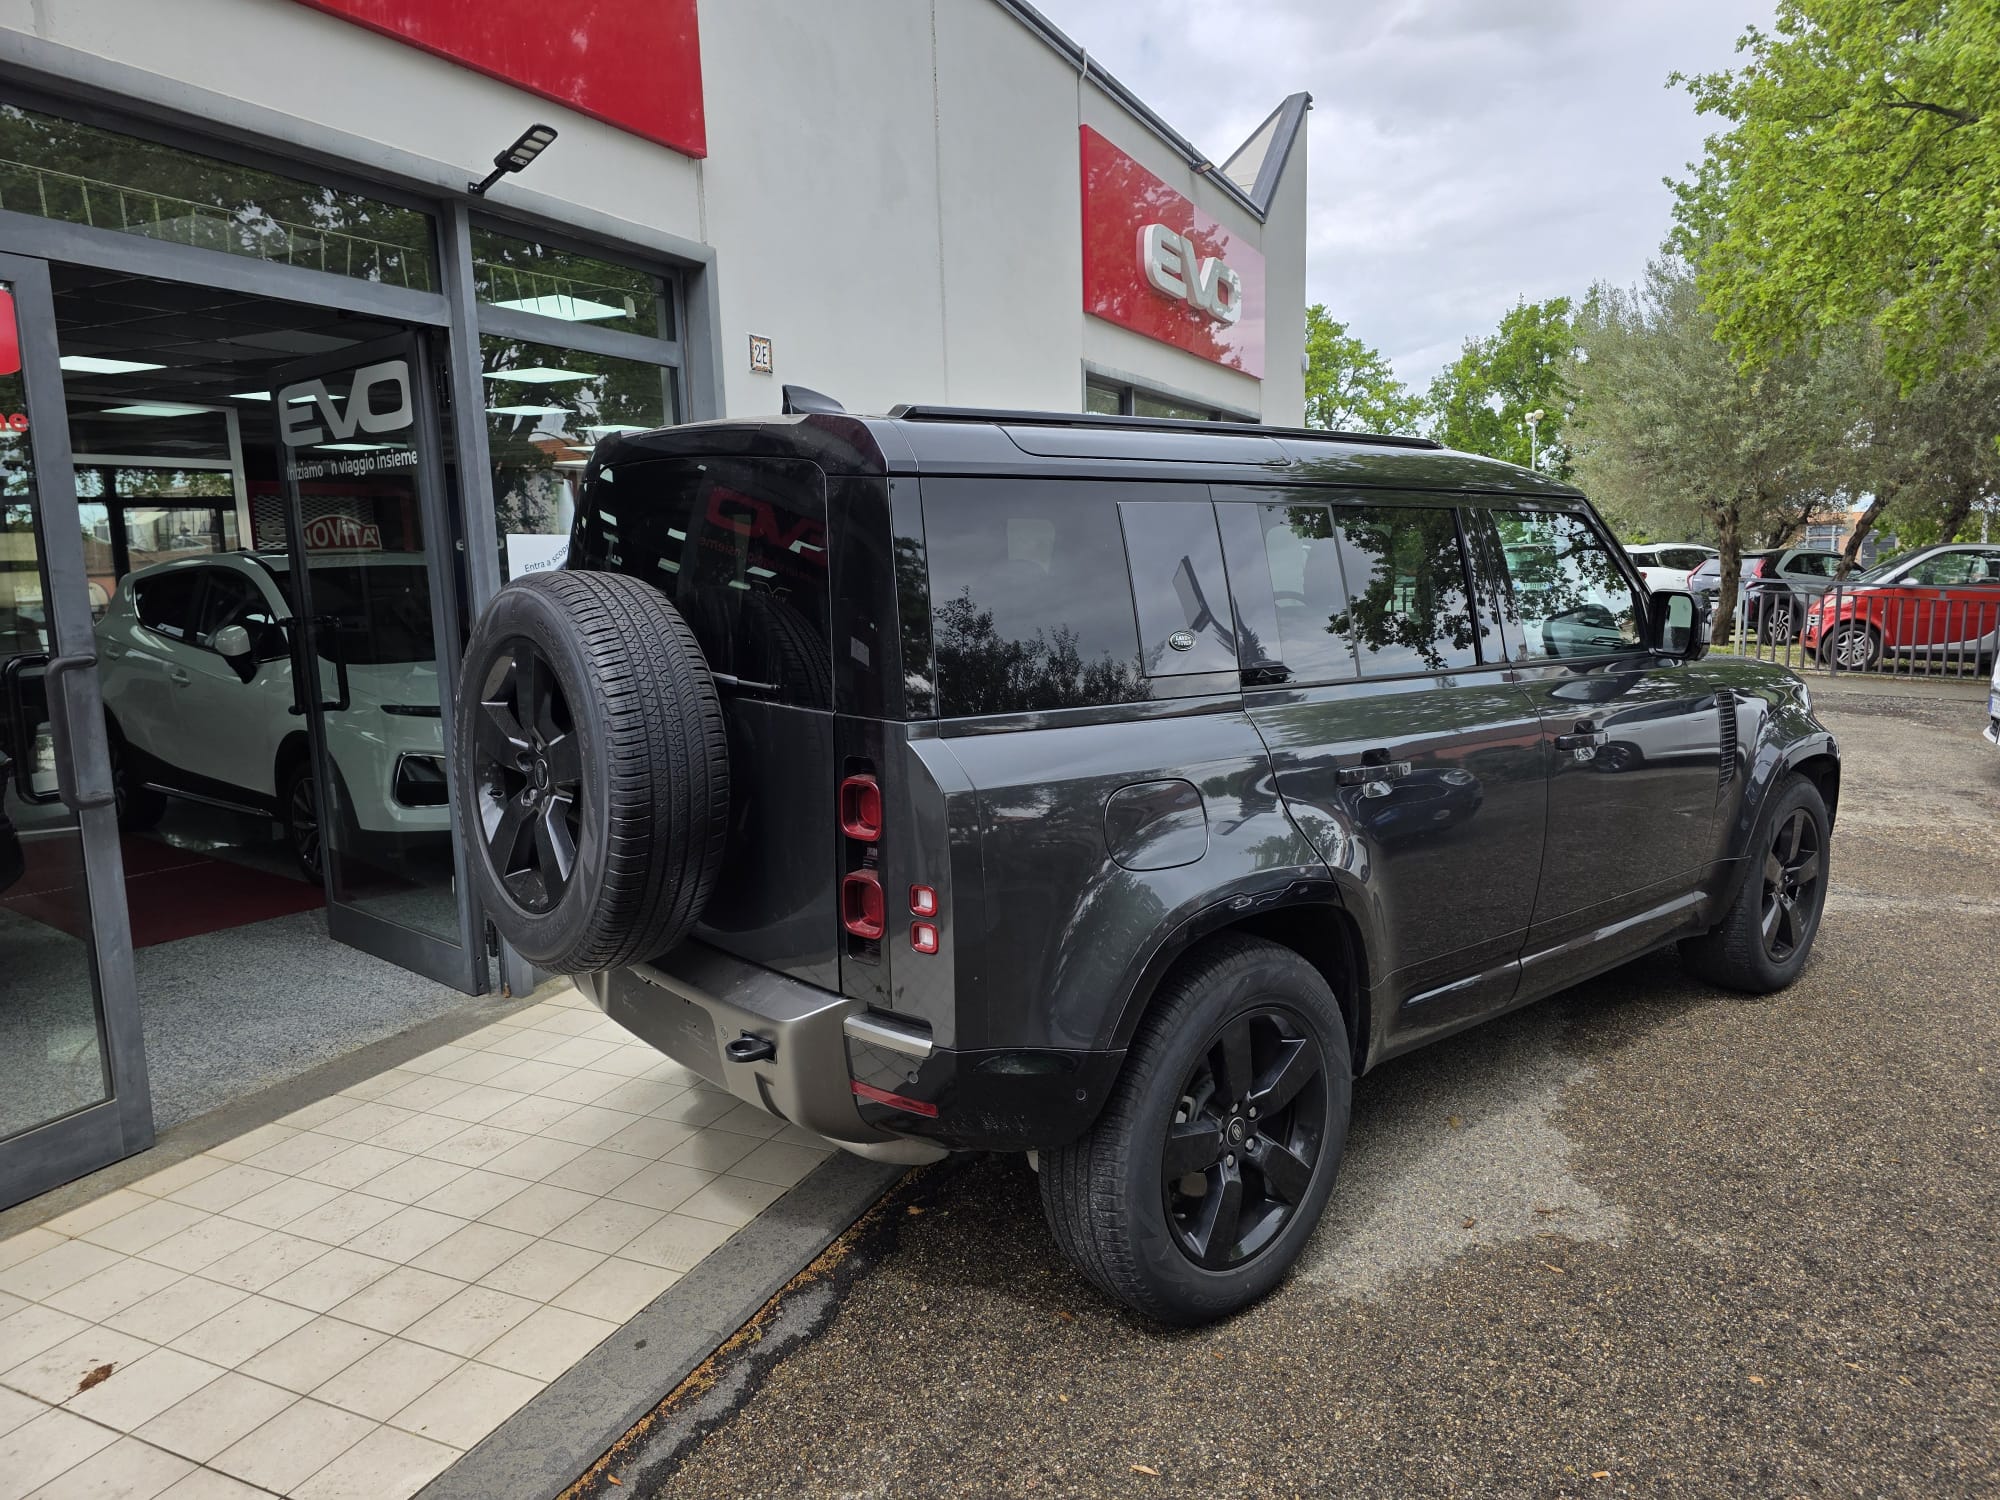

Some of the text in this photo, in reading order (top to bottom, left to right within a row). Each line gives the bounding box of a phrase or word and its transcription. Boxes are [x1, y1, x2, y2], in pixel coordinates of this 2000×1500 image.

[1144, 224, 1241, 323] EVO
[755, 344, 767, 364] 2E
[278, 360, 413, 447] EVO
[339, 456, 374, 476] viaggio
[376, 449, 418, 469] insieme
[524, 560, 545, 572] Entra
